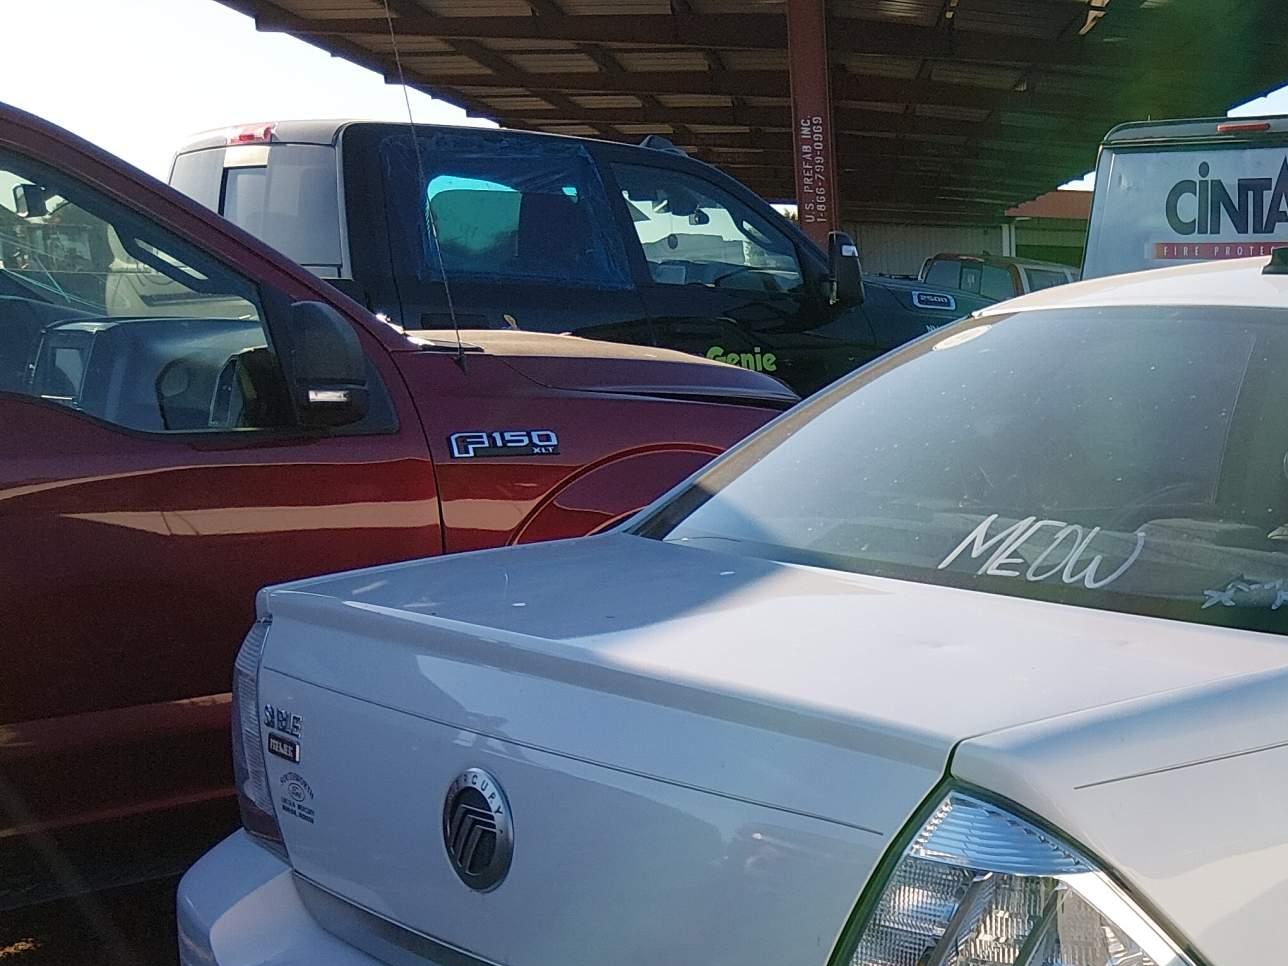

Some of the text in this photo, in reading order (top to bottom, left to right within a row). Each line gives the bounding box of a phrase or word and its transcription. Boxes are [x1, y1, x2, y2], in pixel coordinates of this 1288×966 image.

[801, 115, 815, 223] U.S. PREFAB INC.
[813, 116, 827, 222] 1-866-799-0969
[1164, 246, 1200, 257] FIRE
[706, 346, 777, 371] Genie
[938, 513, 1146, 589] MEOW
